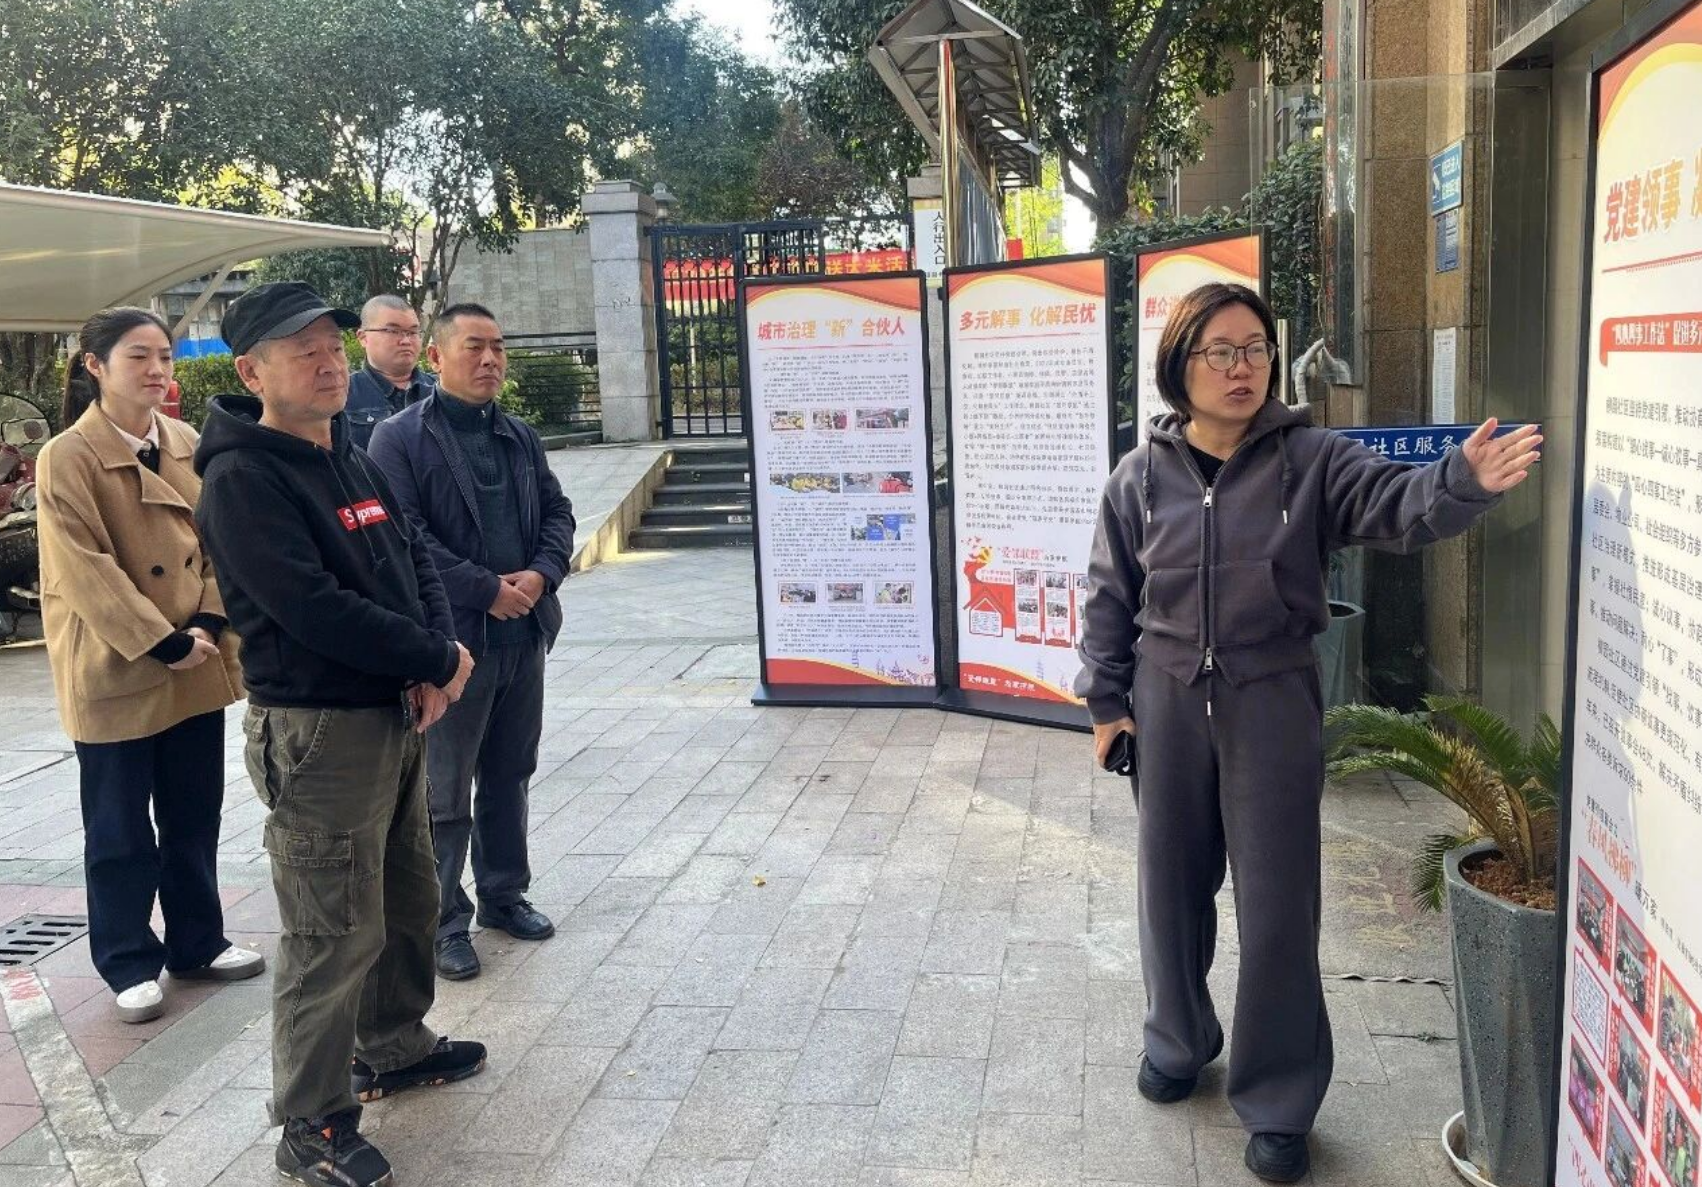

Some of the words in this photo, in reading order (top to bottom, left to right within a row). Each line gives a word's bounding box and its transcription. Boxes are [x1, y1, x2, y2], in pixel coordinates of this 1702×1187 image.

[1604, 159, 1683, 243] 党建领事
[933, 211, 945, 265] 人行出入口
[757, 321, 817, 341] 城市治理
[862, 315, 906, 337] 合伙人
[960, 308, 1023, 331] 多元解事
[1029, 303, 1097, 327] 化解民忧
[1355, 434, 1457, 456] 社区服务
